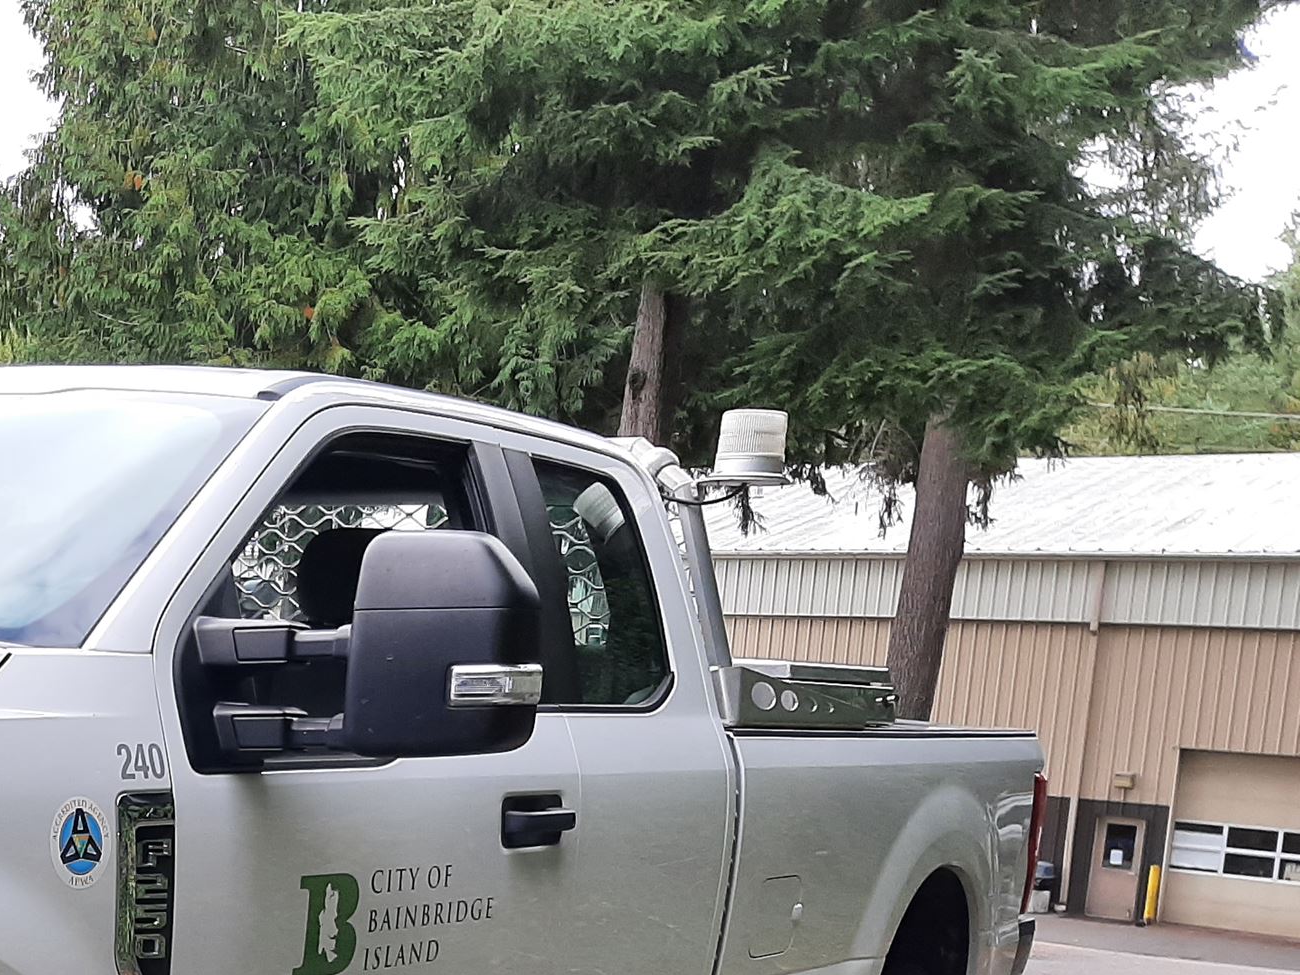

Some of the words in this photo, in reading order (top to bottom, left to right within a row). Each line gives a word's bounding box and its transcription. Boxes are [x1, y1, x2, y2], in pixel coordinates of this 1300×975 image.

[117, 743, 165, 780] 240
[52, 799, 87, 840] ACCREDITED
[88, 803, 109, 839] AGENCY
[371, 867, 420, 894] CITY
[427, 864, 453, 889] OF
[368, 897, 494, 933] BAINBRIDGE
[363, 939, 440, 971] ISLAND
